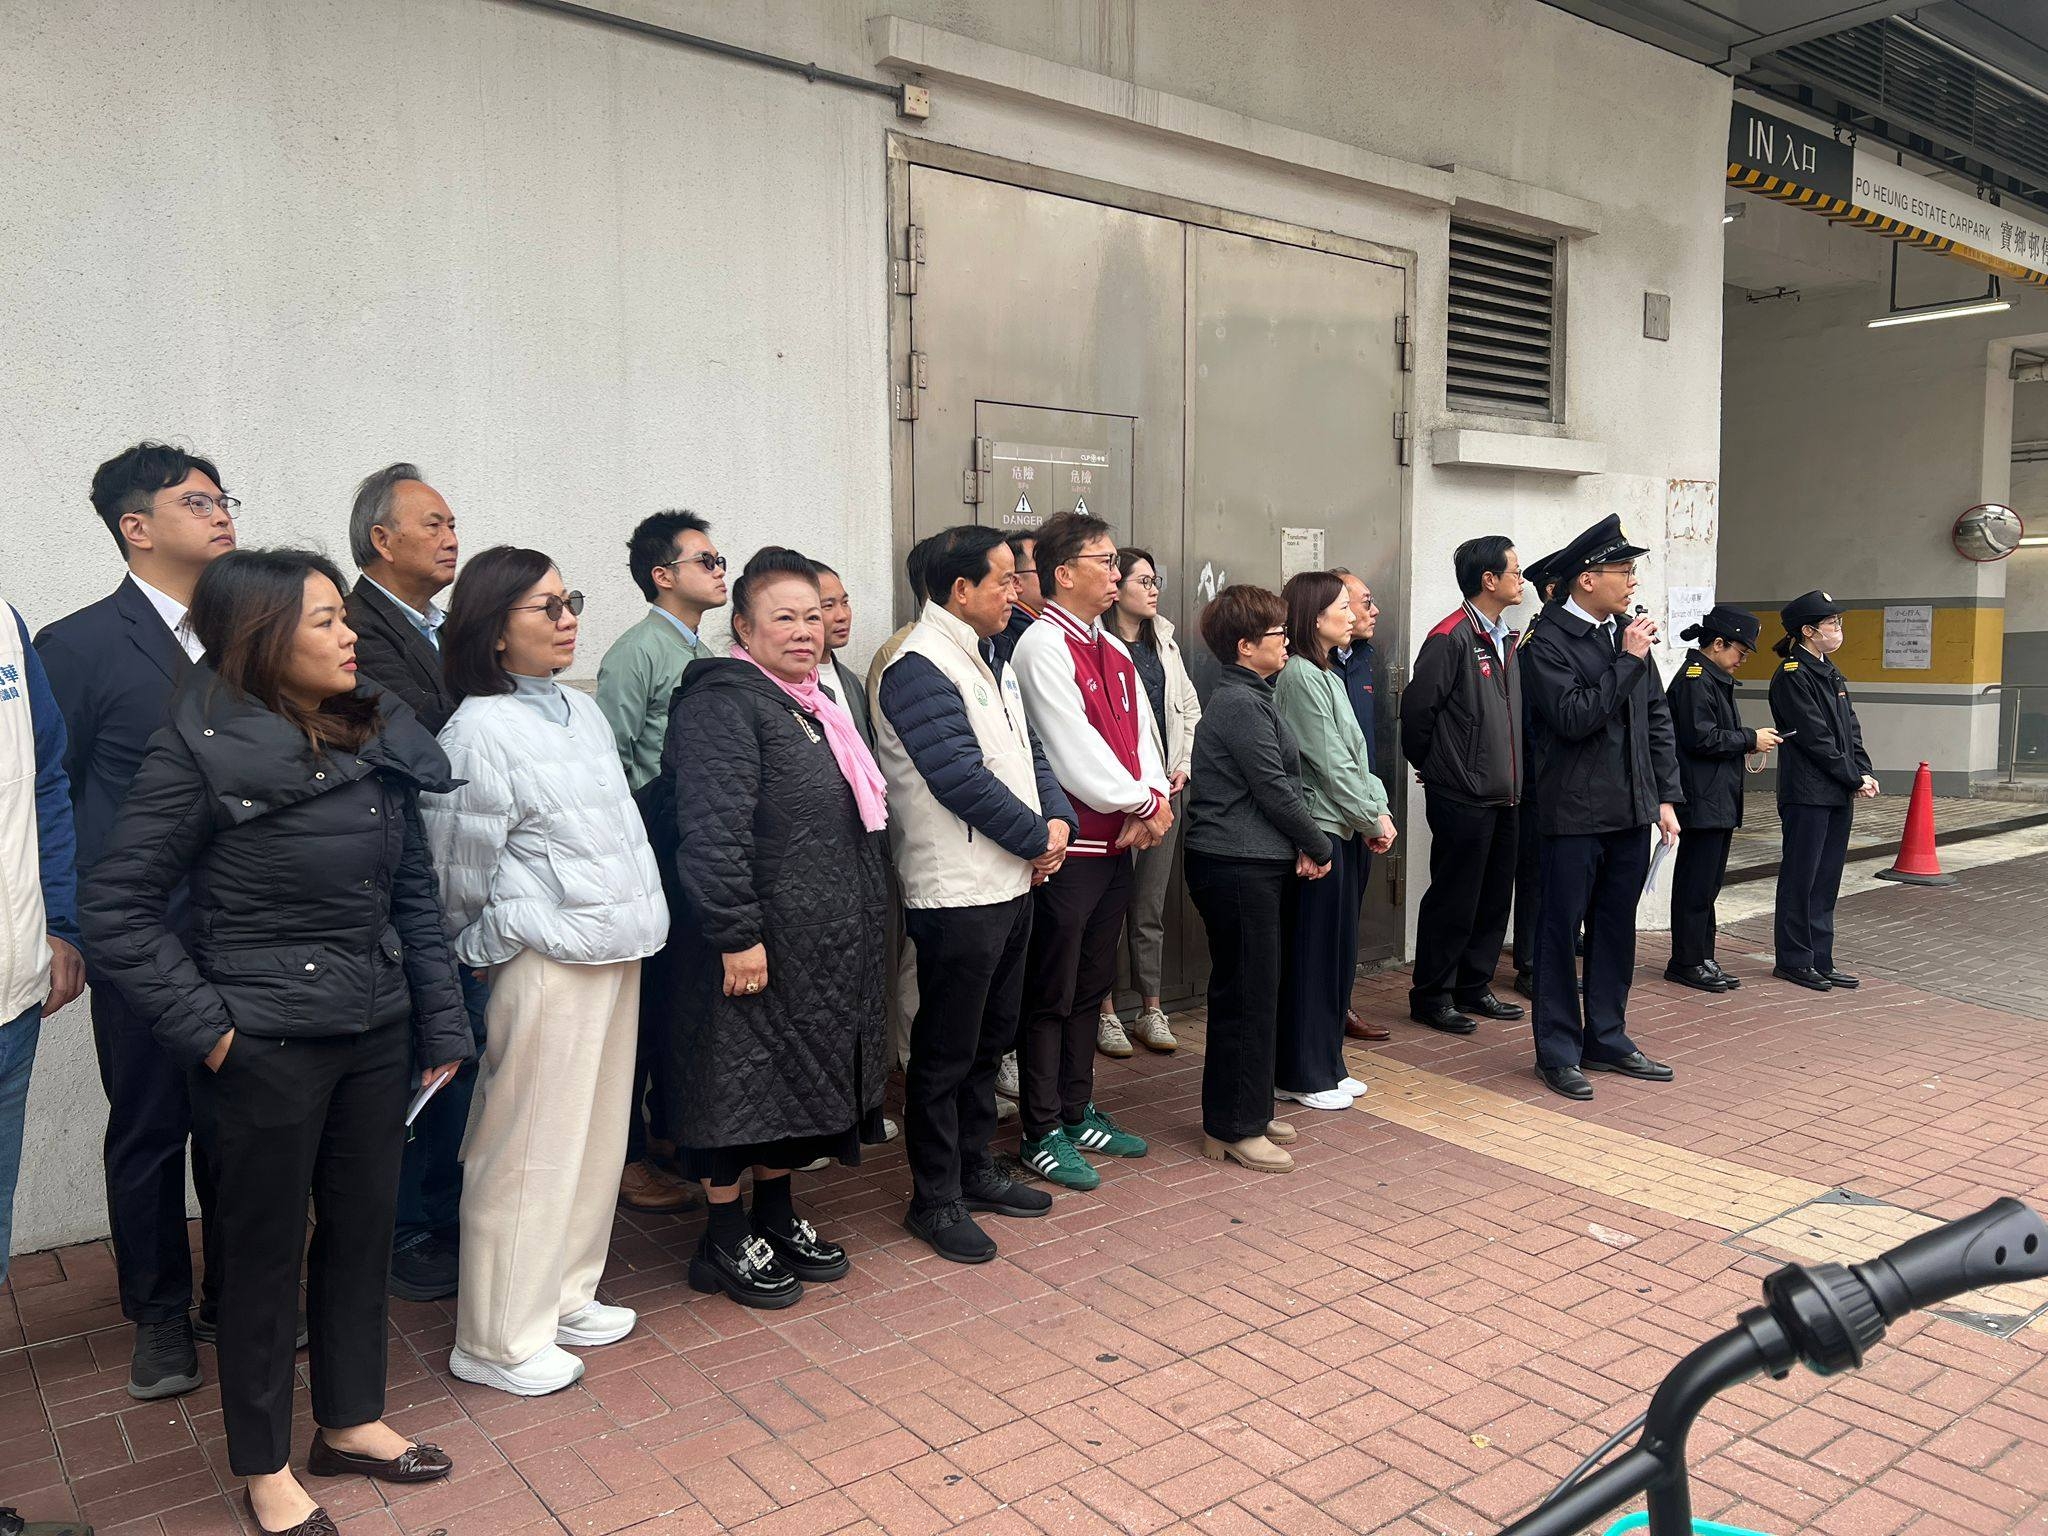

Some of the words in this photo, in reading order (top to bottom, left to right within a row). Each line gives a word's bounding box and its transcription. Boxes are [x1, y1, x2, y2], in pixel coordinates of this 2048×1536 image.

[1749, 117, 1774, 164] IN
[1781, 133, 1816, 173] 入口
[1855, 177, 1870, 196] PO
[1873, 183, 1908, 211] HEUNG
[1911, 198, 1947, 225] ESTATE
[1949, 212, 1990, 241] CARPARK
[1003, 514, 1043, 526] DANGER
[1117, 671, 1130, 713] J
